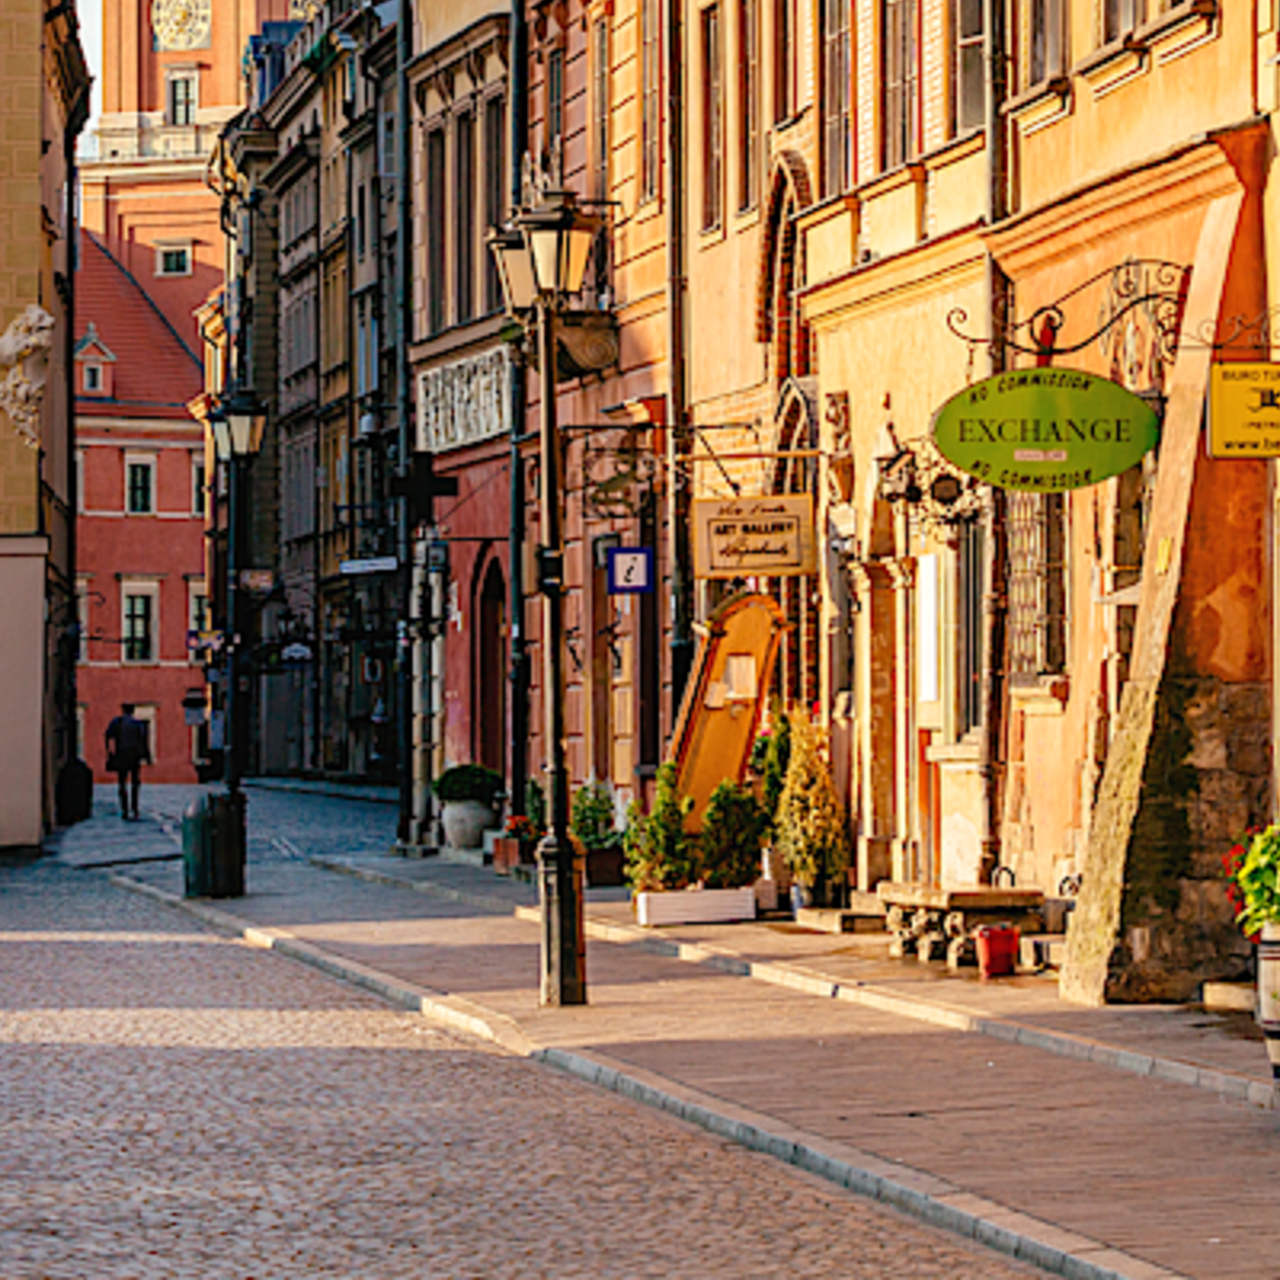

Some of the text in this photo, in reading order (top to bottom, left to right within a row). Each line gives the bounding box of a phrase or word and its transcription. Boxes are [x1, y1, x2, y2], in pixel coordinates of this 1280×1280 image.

[970, 373, 1093, 403] NO COMMISSION
[958, 418, 1132, 443] EXCHANGE
[971, 460, 1092, 487] NO COMMISSION
[715, 522, 793, 535] ART GALLERY
